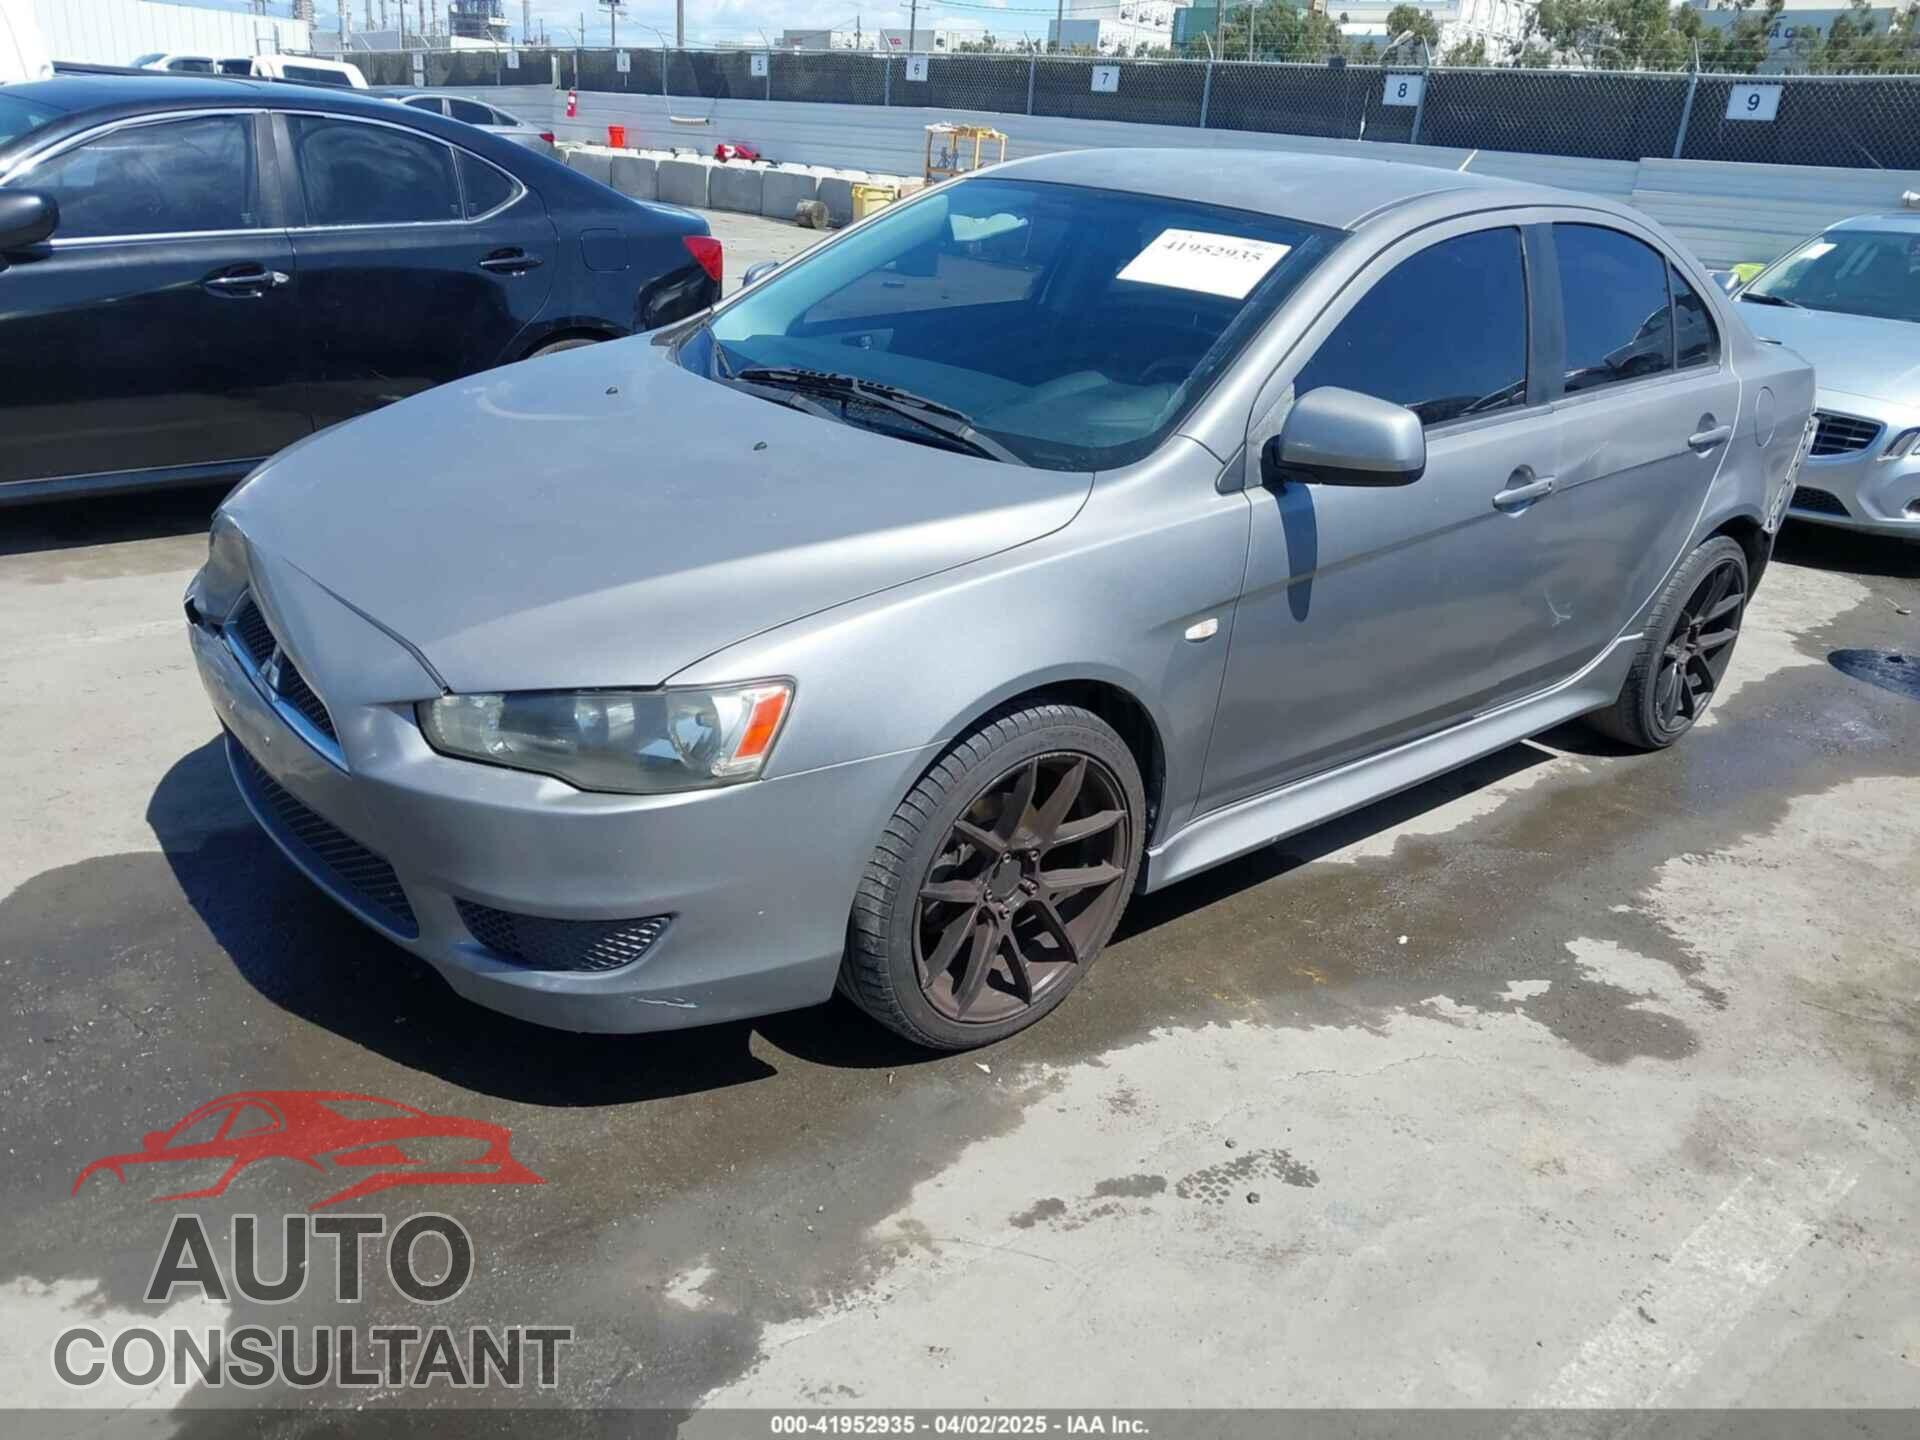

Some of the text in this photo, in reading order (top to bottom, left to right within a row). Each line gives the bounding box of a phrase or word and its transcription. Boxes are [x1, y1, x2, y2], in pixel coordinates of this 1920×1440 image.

[1102, 72, 1109, 84] 7
[1398, 82, 1408, 98] 8
[1747, 93, 1760, 111] 9
